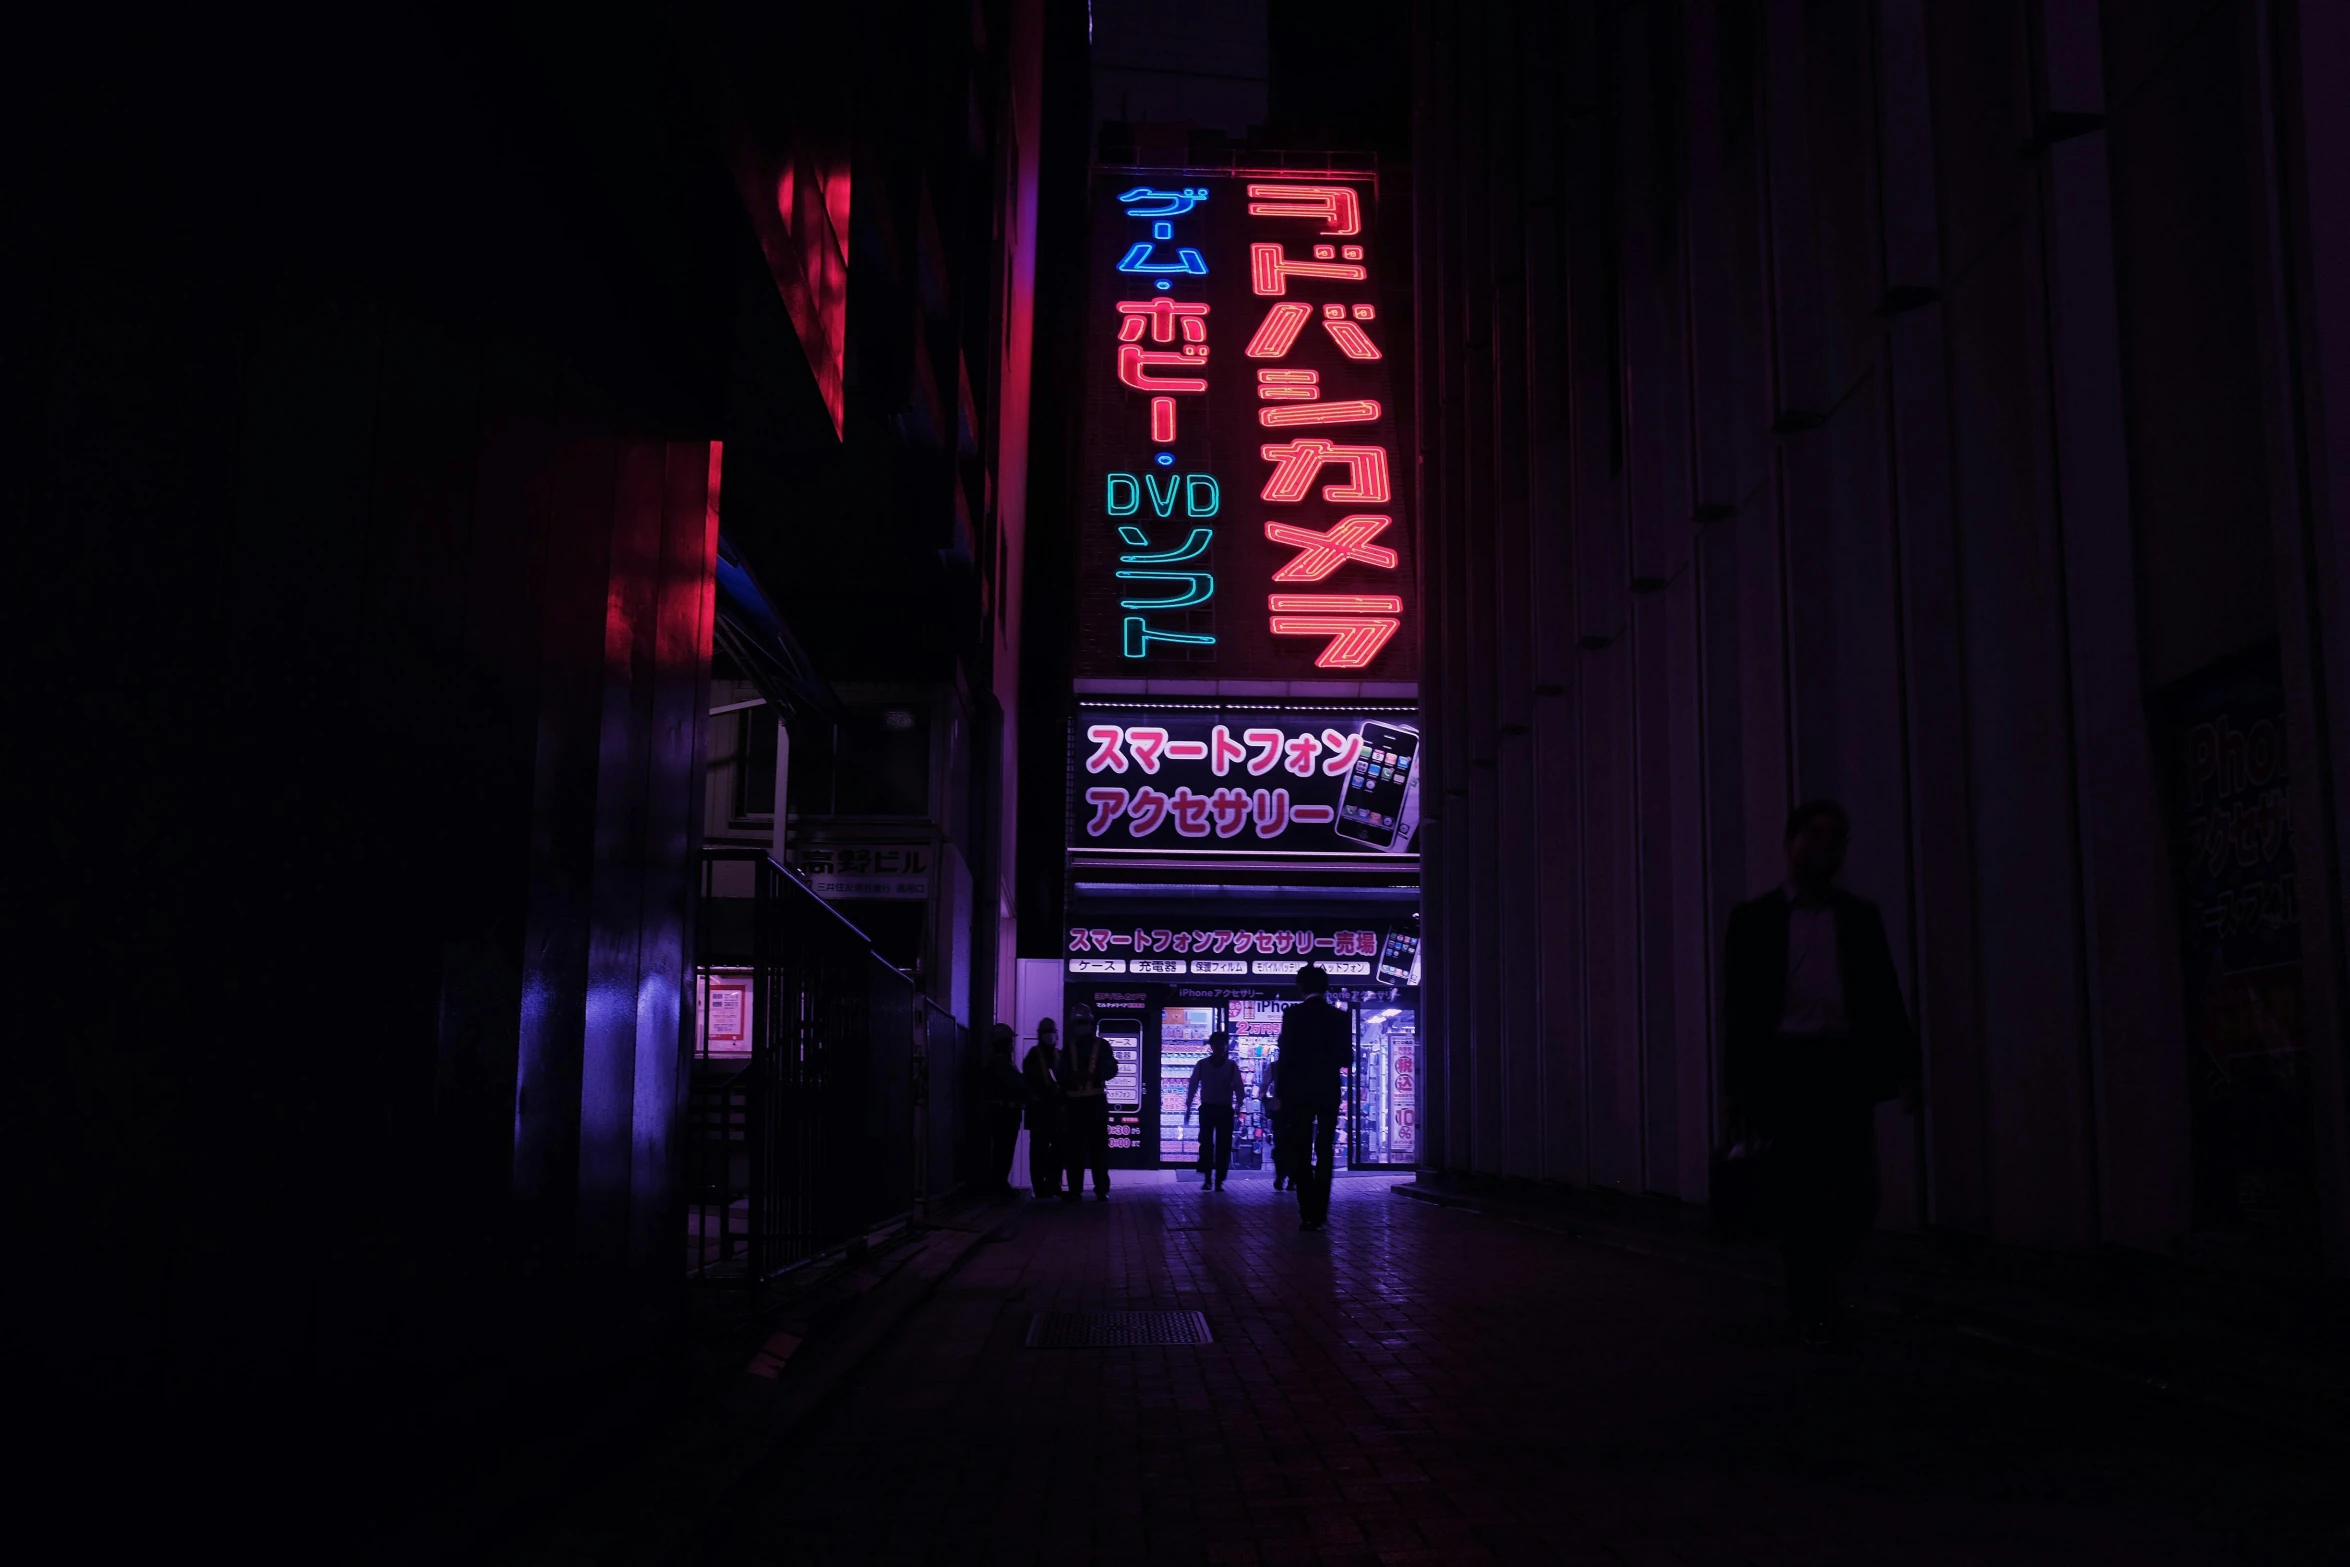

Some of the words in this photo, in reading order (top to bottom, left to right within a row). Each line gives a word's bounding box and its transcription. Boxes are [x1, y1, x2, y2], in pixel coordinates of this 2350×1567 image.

[1245, 183, 1403, 669] ヨドバシカメラ
[1086, 725, 1364, 777] スマートフォン
[1085, 786, 1334, 839] アクセサリー
[801, 849, 927, 874] 高野ビル
[1069, 928, 1377, 956] スマートフォンアクセサリー売場
[1079, 960, 1116, 971] ケース
[1139, 960, 1177, 972] 充電器
[1195, 961, 1243, 973] 保護フィルム
[1179, 988, 1264, 998] iPhoneアクセサリー
